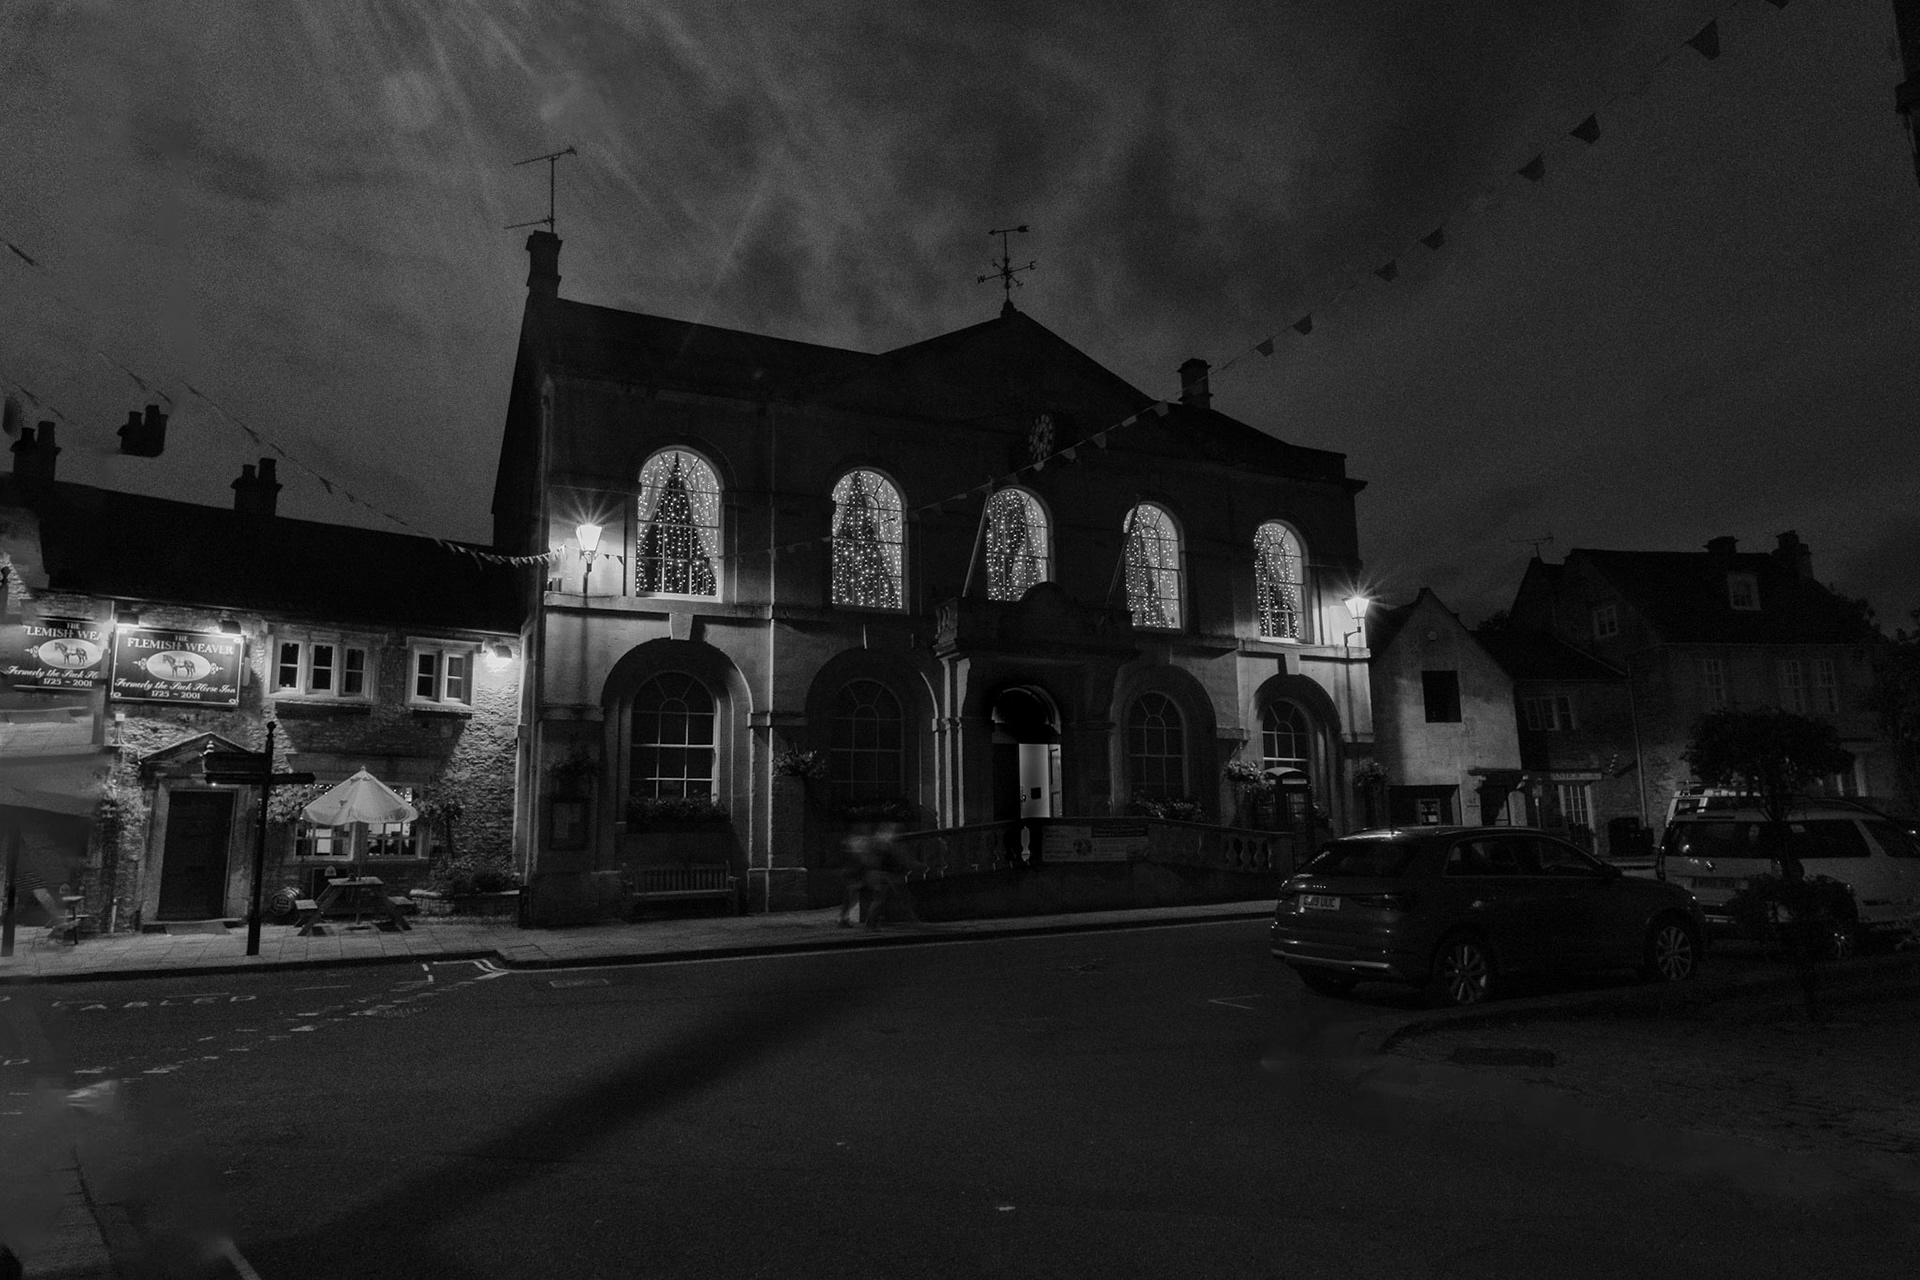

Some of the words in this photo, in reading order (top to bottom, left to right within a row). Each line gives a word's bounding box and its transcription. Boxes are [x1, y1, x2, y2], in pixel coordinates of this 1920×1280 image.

[66, 622, 81, 630] THE
[174, 634, 189, 642] THE
[127, 637, 182, 650] FLEMISH
[186, 642, 234, 655] WEAVER
[7, 665, 45, 679] Formerly
[45, 668, 60, 677] the
[43, 678, 62, 686] 1725
[73, 679, 93, 687] 2001
[115, 677, 153, 691] Formerly
[154, 681, 168, 690] the
[169, 681, 193, 691] Pack
[193, 683, 218, 693] Horse
[219, 684, 236, 694] Inn
[151, 689, 170, 698] 1725
[180, 691, 201, 699] 2001
